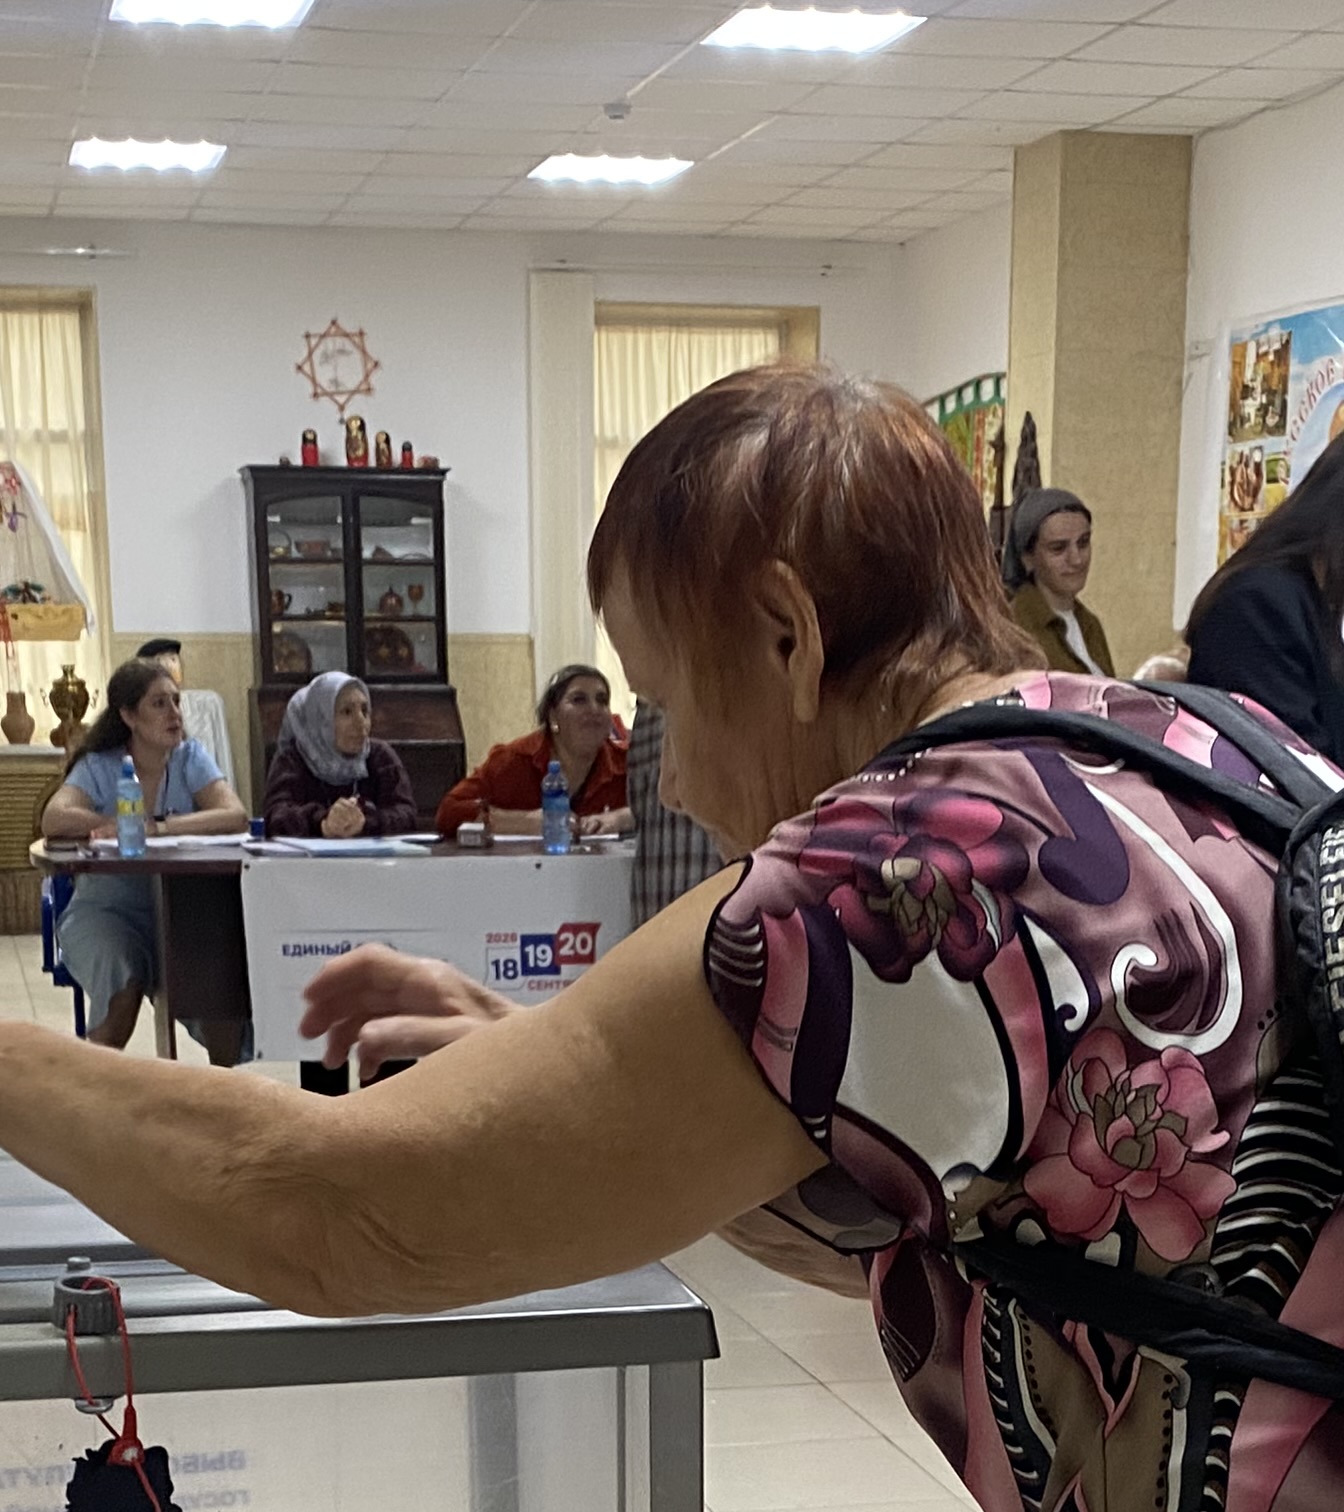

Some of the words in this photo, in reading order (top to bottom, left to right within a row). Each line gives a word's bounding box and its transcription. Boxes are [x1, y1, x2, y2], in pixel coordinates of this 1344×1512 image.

[491, 959, 519, 981] 18
[524, 943, 554, 968] 19
[559, 932, 594, 956] 20
